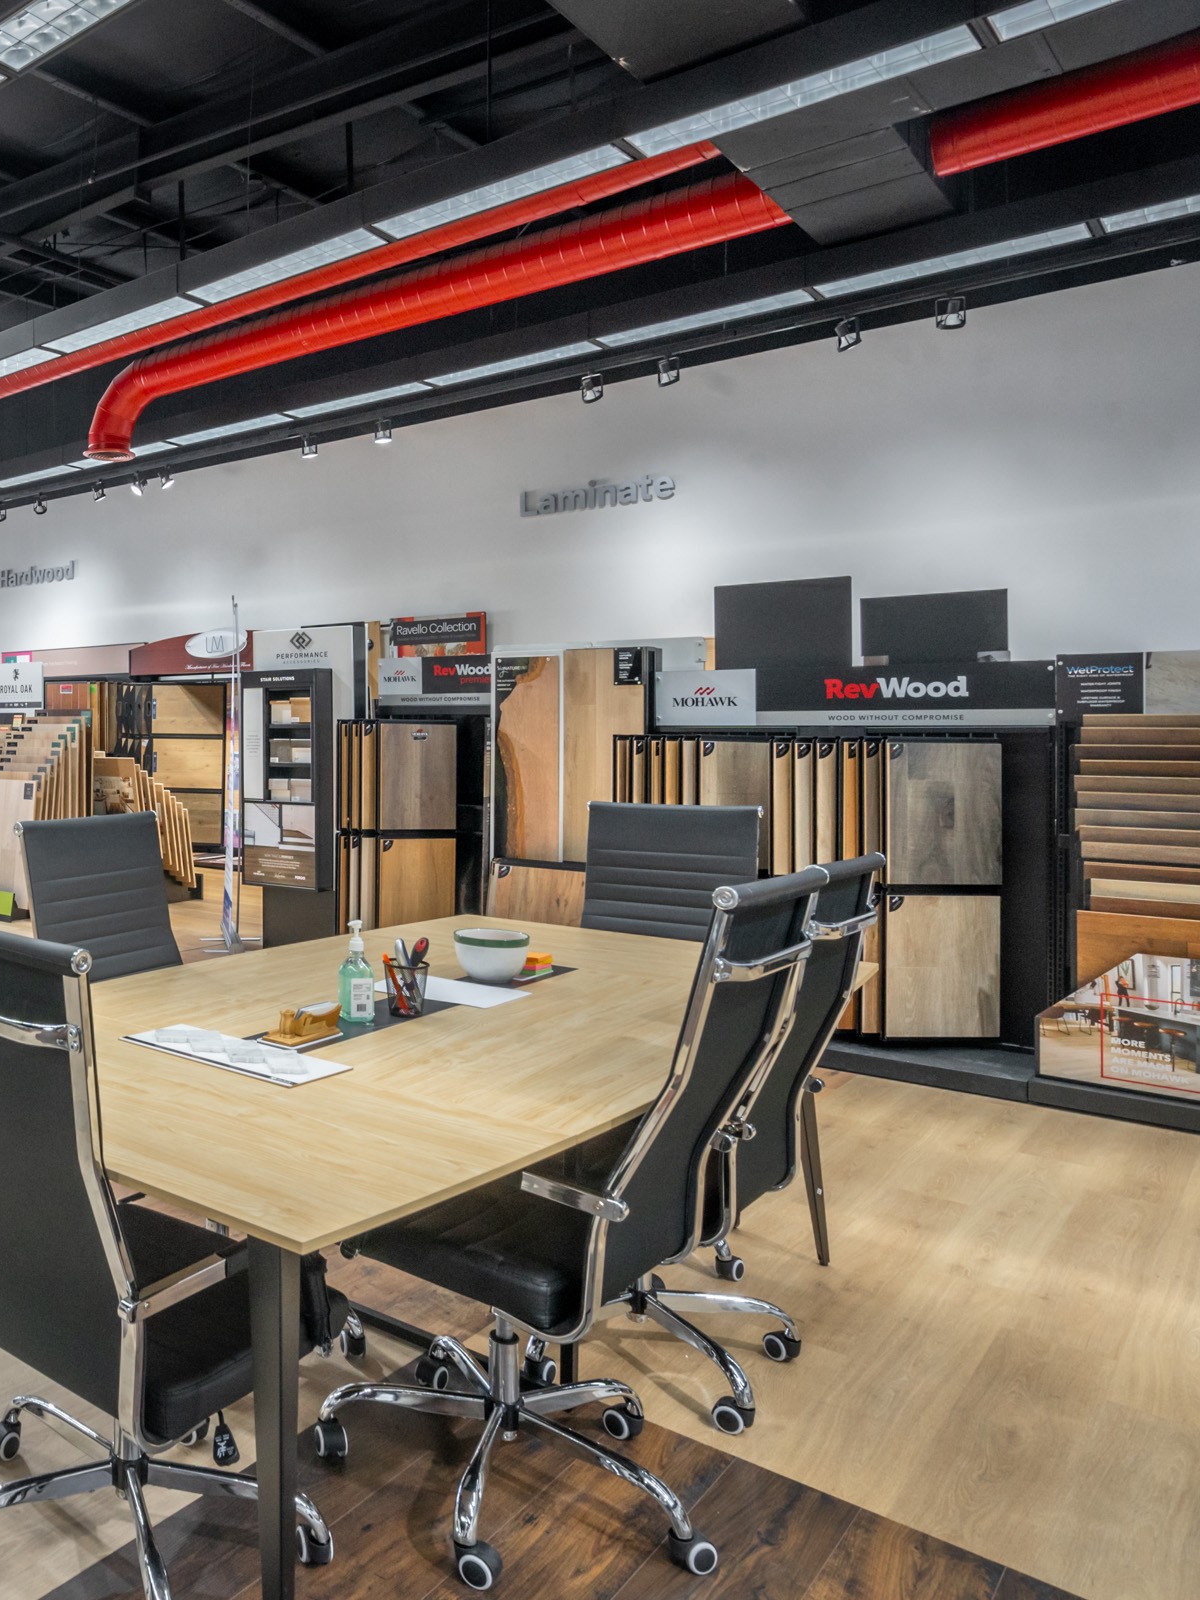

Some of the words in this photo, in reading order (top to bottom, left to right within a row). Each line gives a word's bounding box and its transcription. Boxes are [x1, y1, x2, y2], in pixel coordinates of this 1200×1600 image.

[520, 475, 676, 518] Laminate
[0, 560, 75, 588] Hardwood
[396, 622, 428, 636] Ravello
[429, 622, 477, 634] Collection
[276, 651, 329, 660] PERFORMANCE
[1066, 665, 1135, 674] WetProtect
[460, 676, 492, 685] premie
[824, 676, 970, 699] RevWood
[0, 685, 18, 694] ROYAL
[20, 684, 33, 693] OAK
[672, 697, 738, 707] MOHAWK
[1110, 1037, 1145, 1049] MORE
[1110, 1047, 1171, 1062] MOMENTS
[1111, 1056, 1134, 1067] ARE
[1136, 1059, 1173, 1072] MADE
[1110, 1065, 1129, 1075] ON
[1132, 1067, 1190, 1084] MOHAWK
